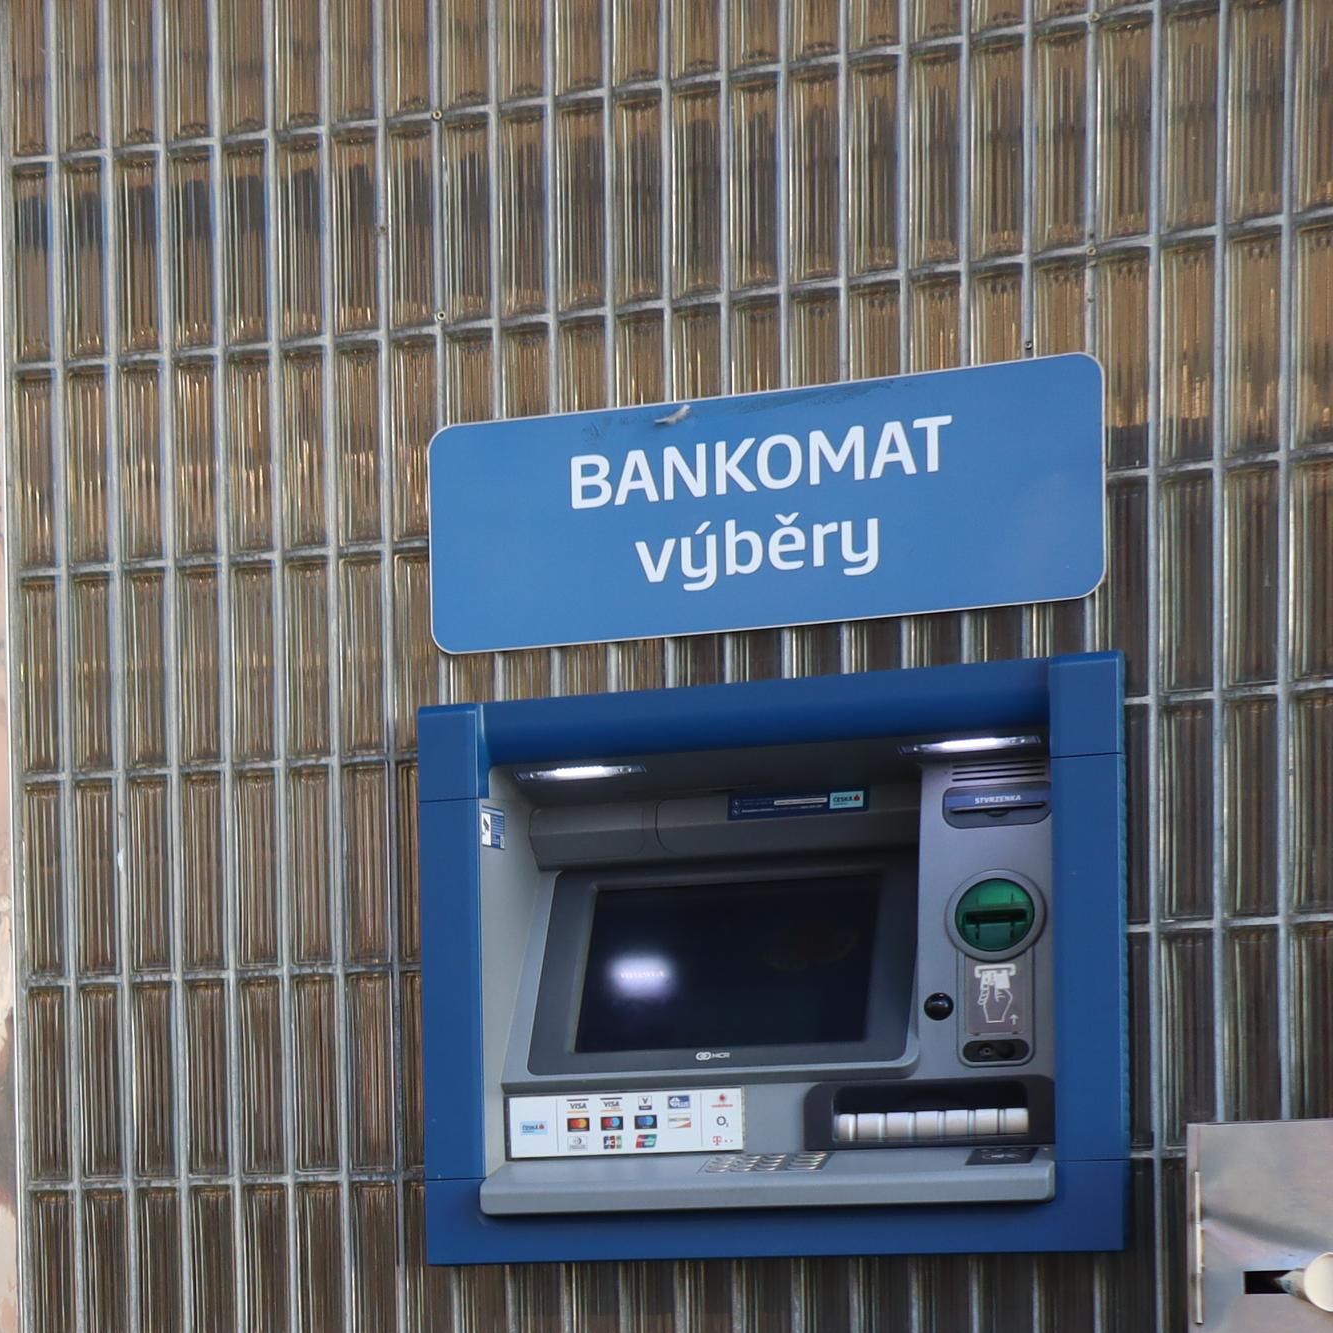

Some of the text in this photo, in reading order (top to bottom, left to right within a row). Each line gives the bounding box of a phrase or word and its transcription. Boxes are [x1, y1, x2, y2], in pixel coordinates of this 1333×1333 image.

[570, 414, 953, 510] BANKOMAT
[634, 511, 880, 592] výběry
[569, 1102, 587, 1110] VISA
[603, 1100, 620, 1108] VISA
